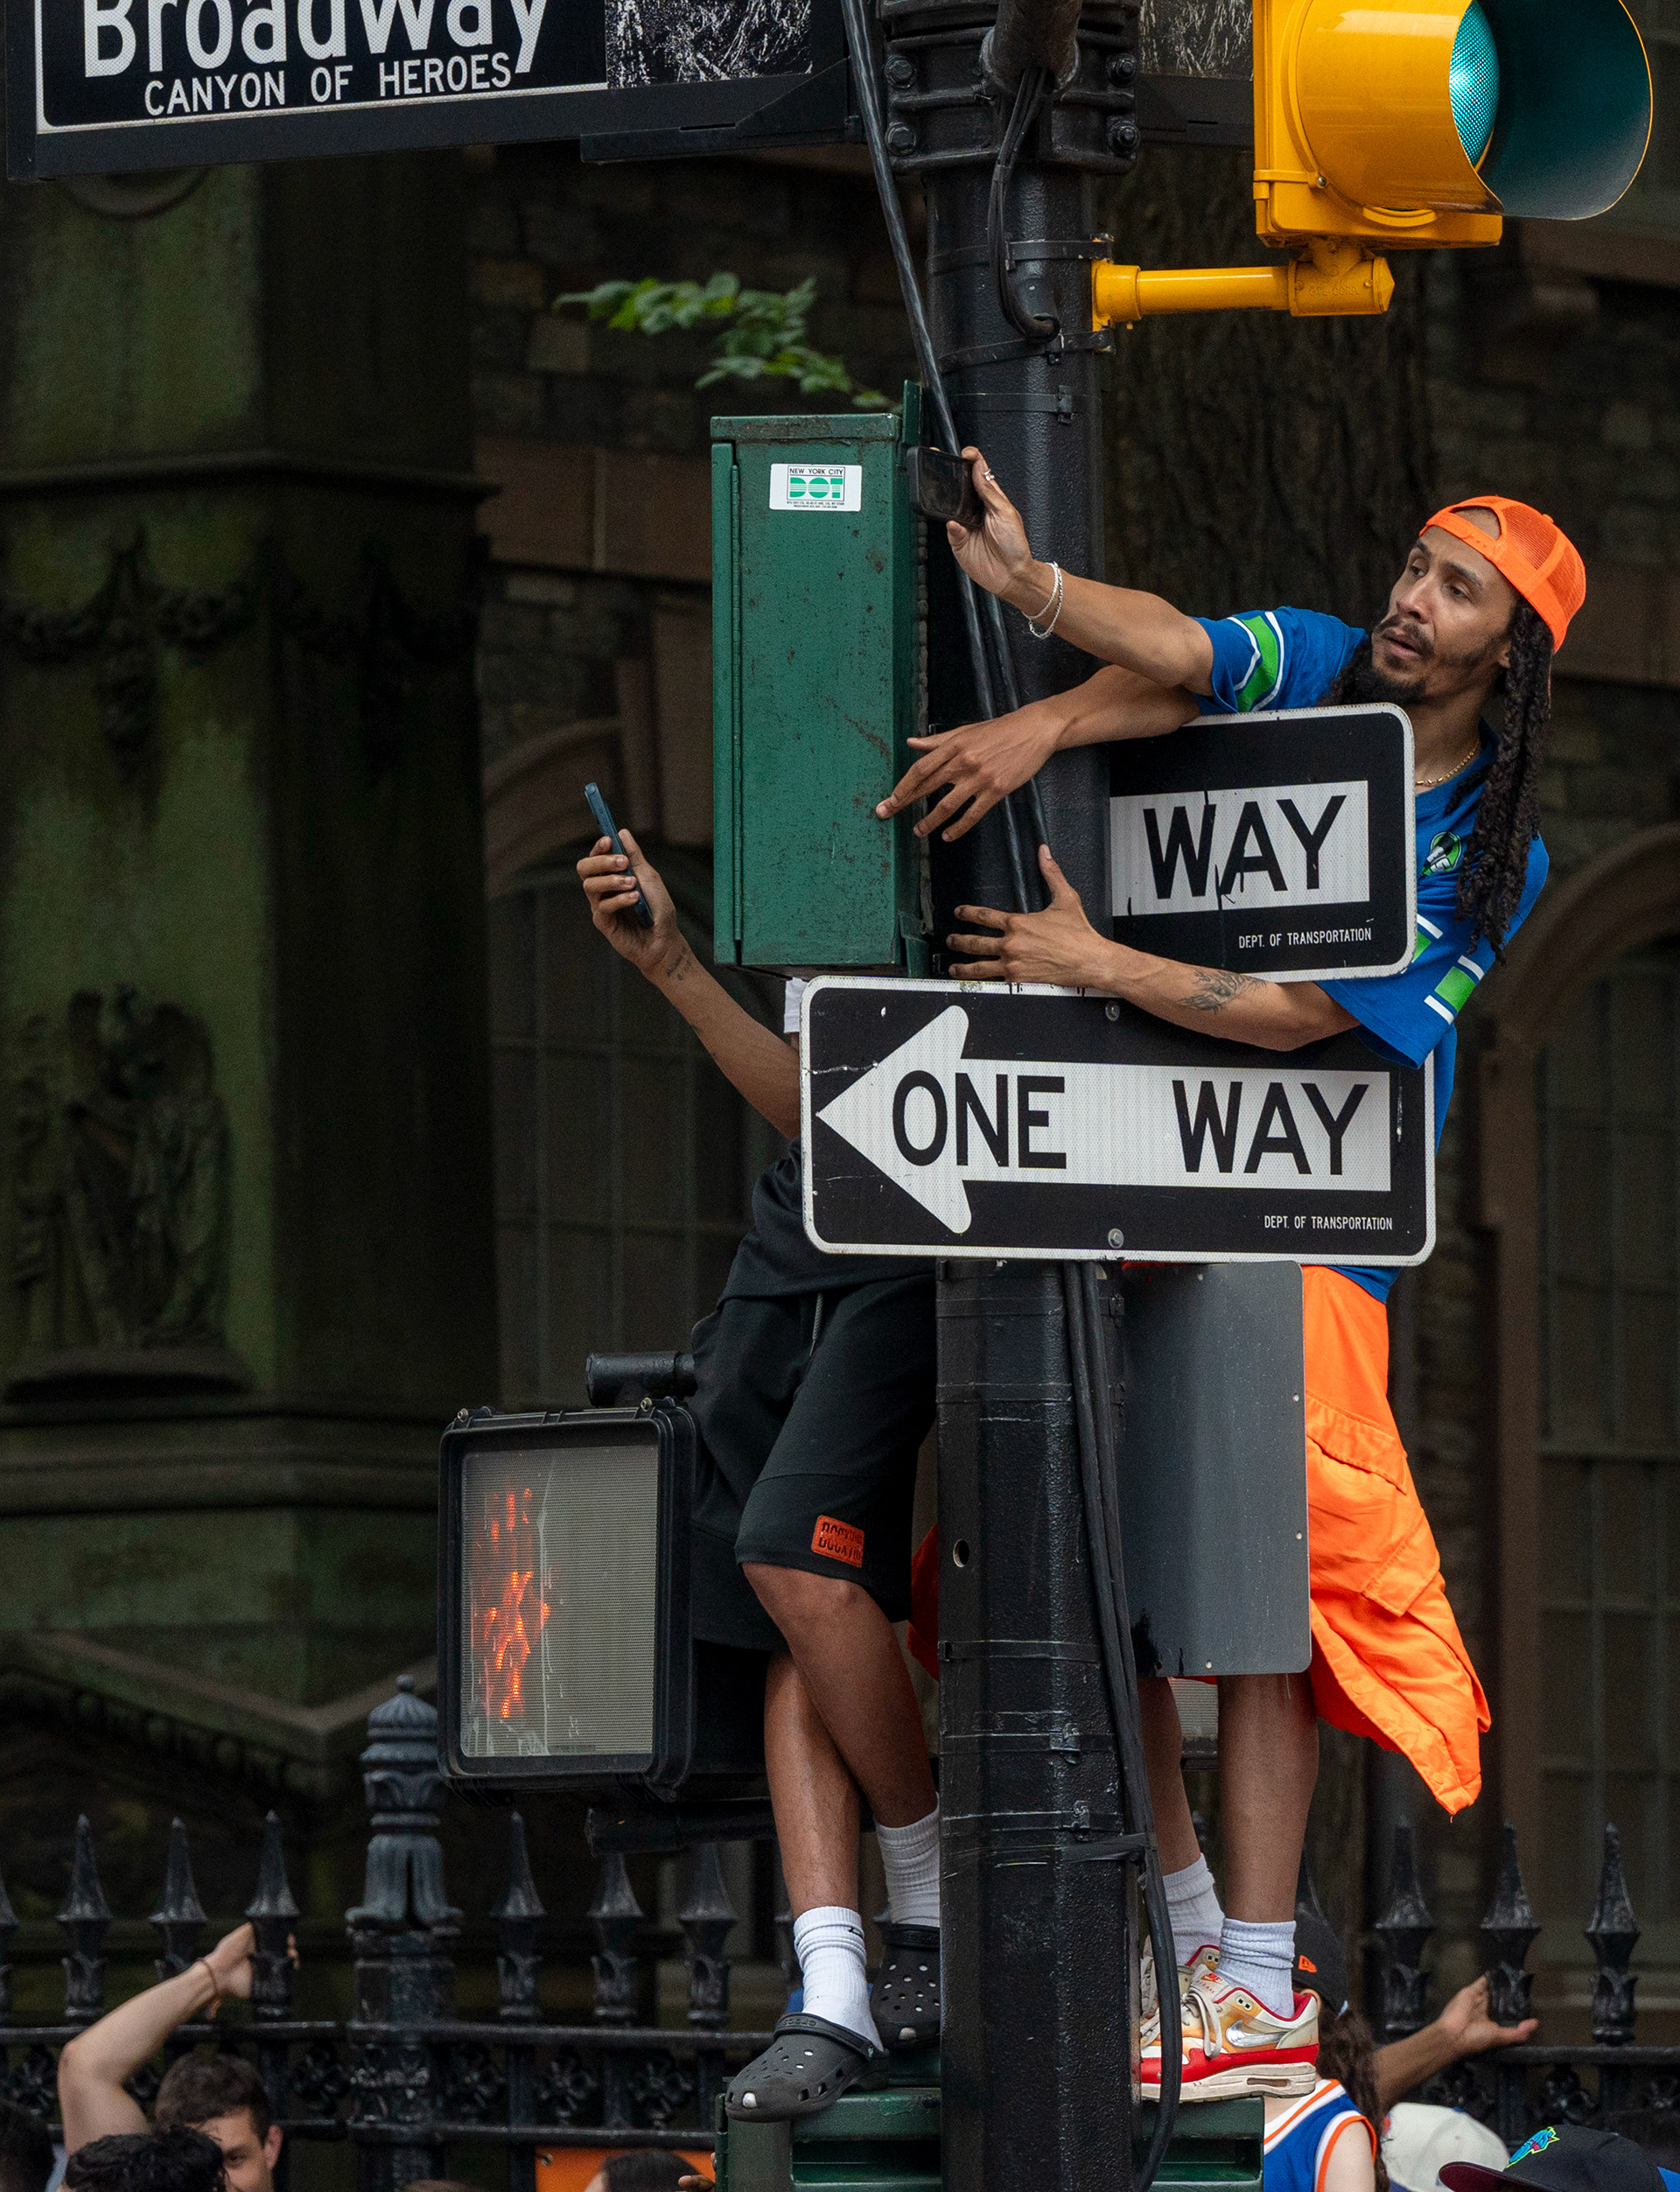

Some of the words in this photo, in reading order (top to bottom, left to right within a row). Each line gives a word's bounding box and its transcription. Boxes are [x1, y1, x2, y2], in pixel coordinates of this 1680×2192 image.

[144, 70, 285, 116] CANYON
[311, 65, 353, 102] OF
[379, 53, 511, 97] HEROES
[789, 477, 843, 498] DOT
[1143, 795, 1347, 900] WAY
[1238, 935, 1265, 949] DEPT.
[1270, 934, 1282, 946] OF
[1287, 928, 1371, 945] TRANSPORTATION
[892, 1070, 1067, 1169] ONE
[1172, 1080, 1369, 1175] WAY
[1264, 1215, 1290, 1229] DEPT.
[1294, 1215, 1306, 1229] OF
[1312, 1216, 1393, 1230] TRANSPORTATION
